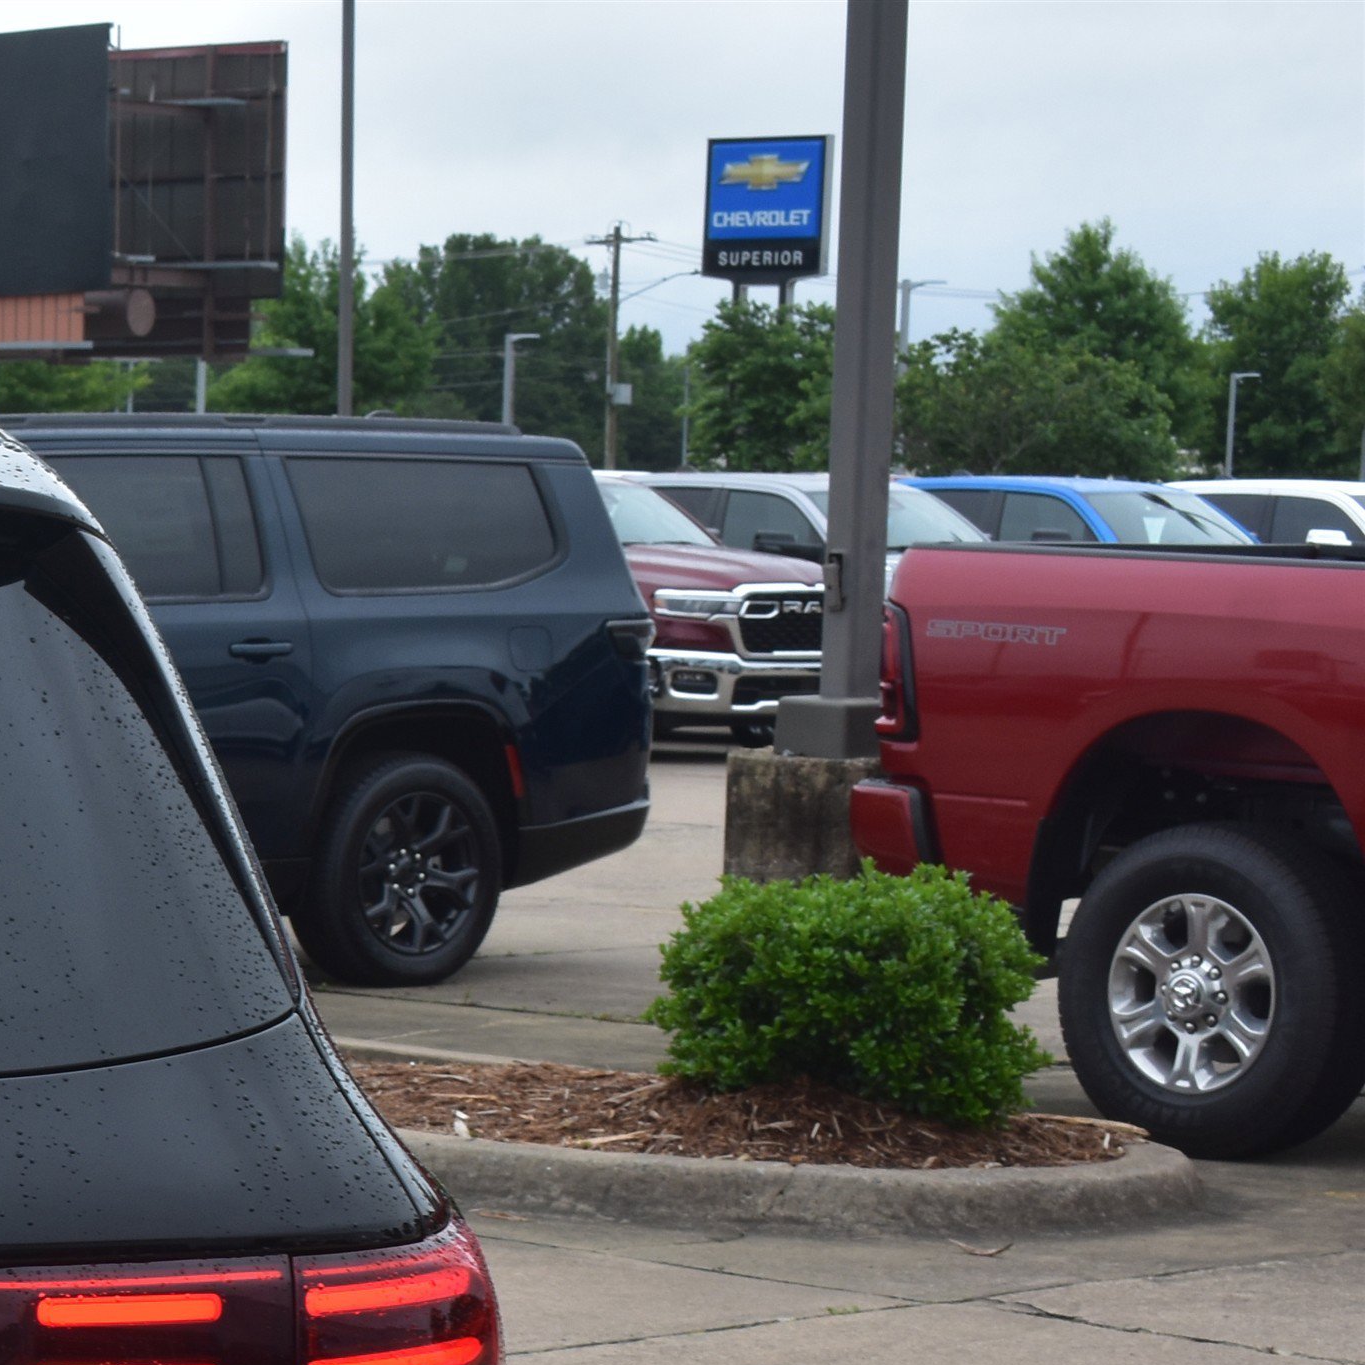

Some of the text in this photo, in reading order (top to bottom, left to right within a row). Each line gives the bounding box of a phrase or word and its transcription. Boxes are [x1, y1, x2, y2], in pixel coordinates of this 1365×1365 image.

[712, 208, 812, 229] CHEVROLET
[717, 249, 804, 267] SUPERIOR
[782, 600, 822, 614] RA
[925, 618, 1067, 646] SPORT
